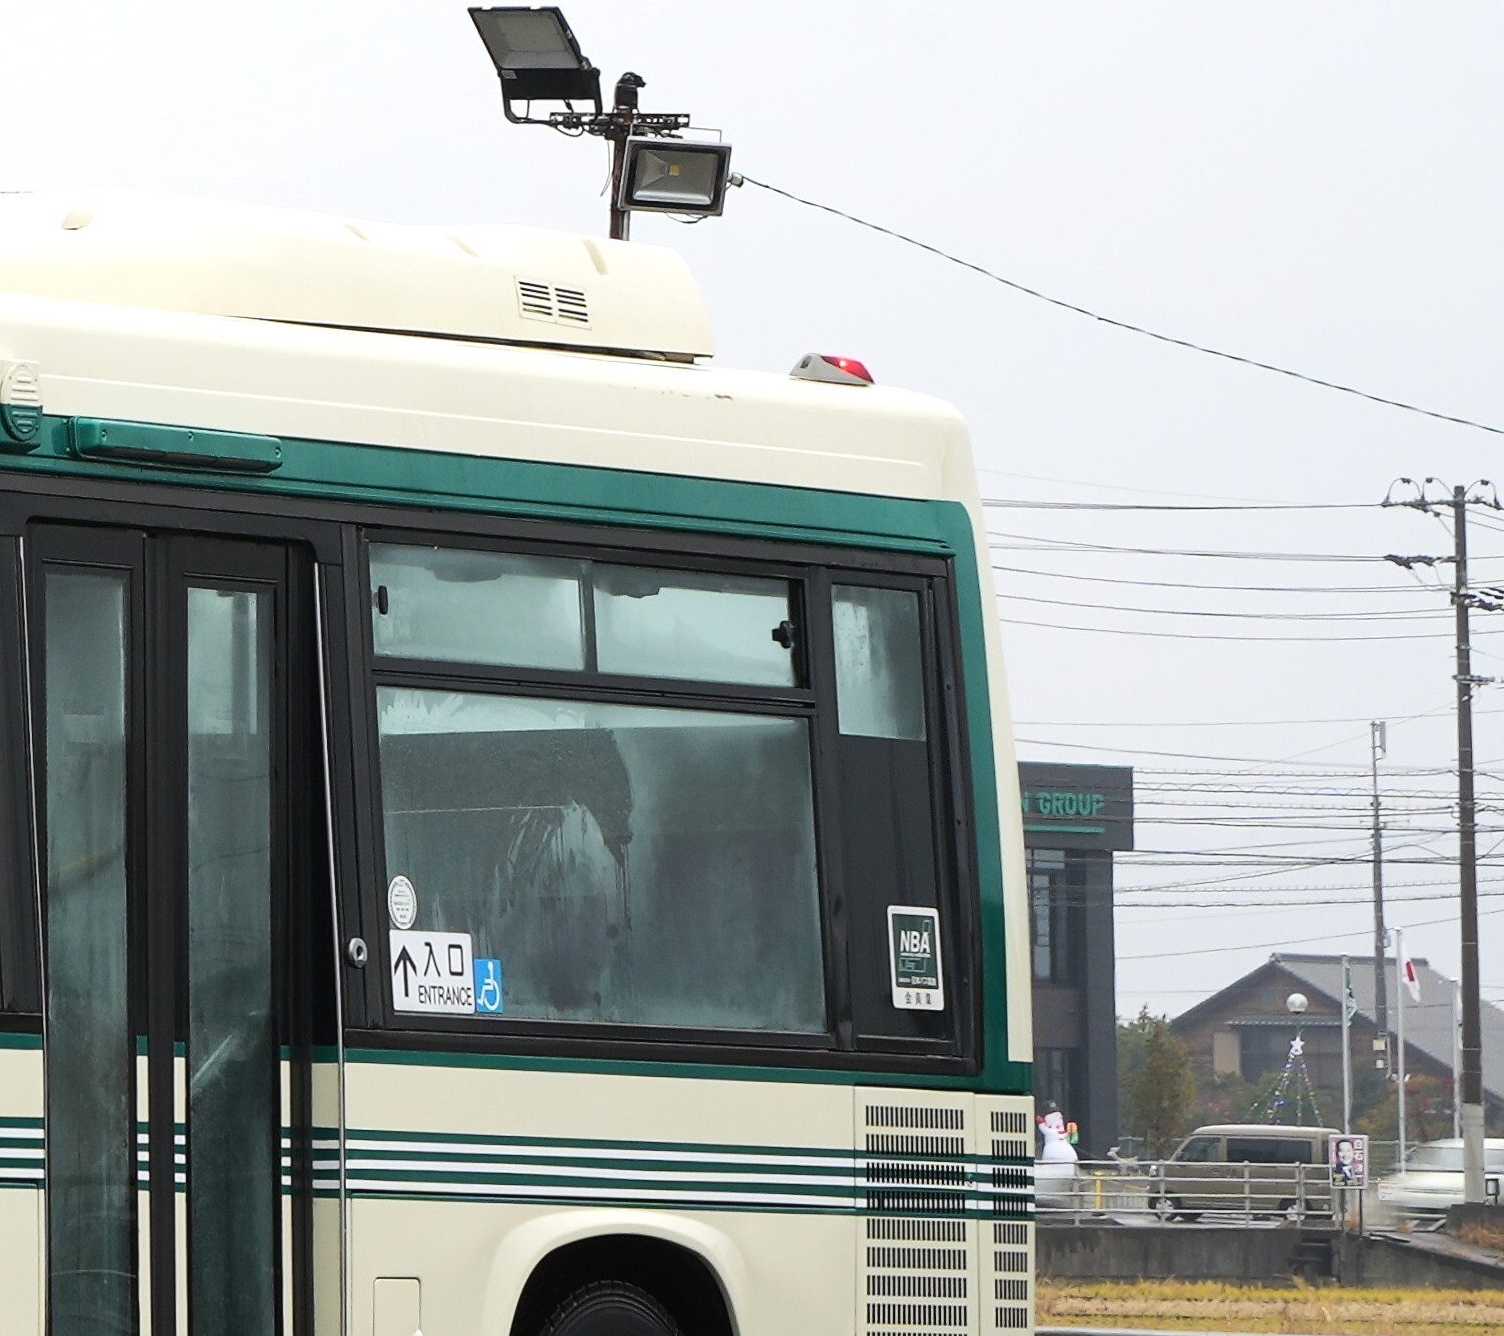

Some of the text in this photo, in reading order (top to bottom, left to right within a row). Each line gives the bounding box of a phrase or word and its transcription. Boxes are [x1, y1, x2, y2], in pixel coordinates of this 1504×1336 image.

[1037, 792, 1105, 815] GROUP
[900, 929, 930, 954] NBA
[423, 941, 464, 978] 入口
[418, 984, 472, 1006] ENTRANCE
